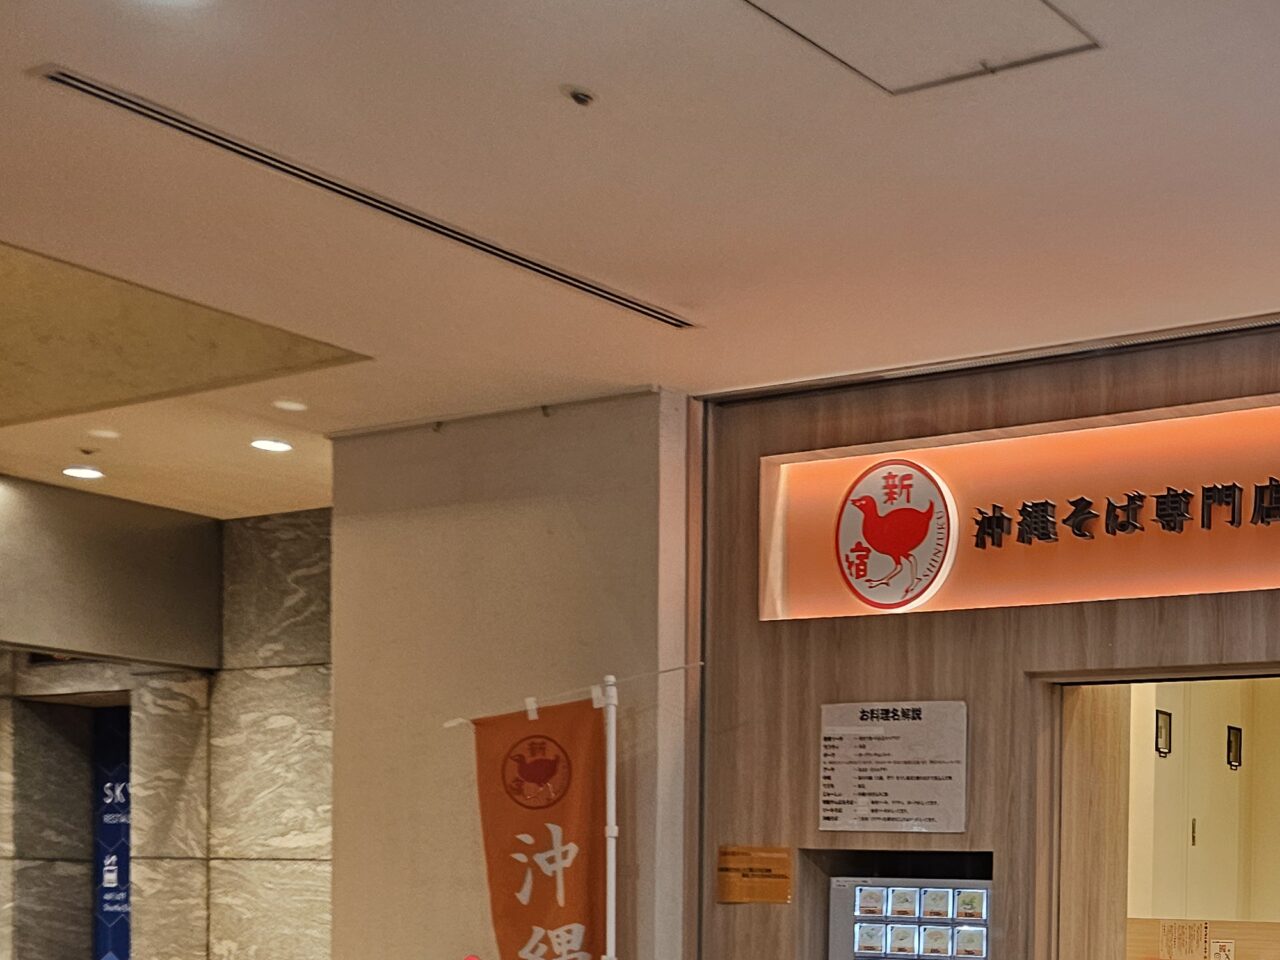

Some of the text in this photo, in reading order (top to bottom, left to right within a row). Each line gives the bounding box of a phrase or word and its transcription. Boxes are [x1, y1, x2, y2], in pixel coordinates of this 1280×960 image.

[881, 471, 914, 505] 新
[845, 540, 872, 580] 宿
[858, 707, 922, 722] お料理名解説
